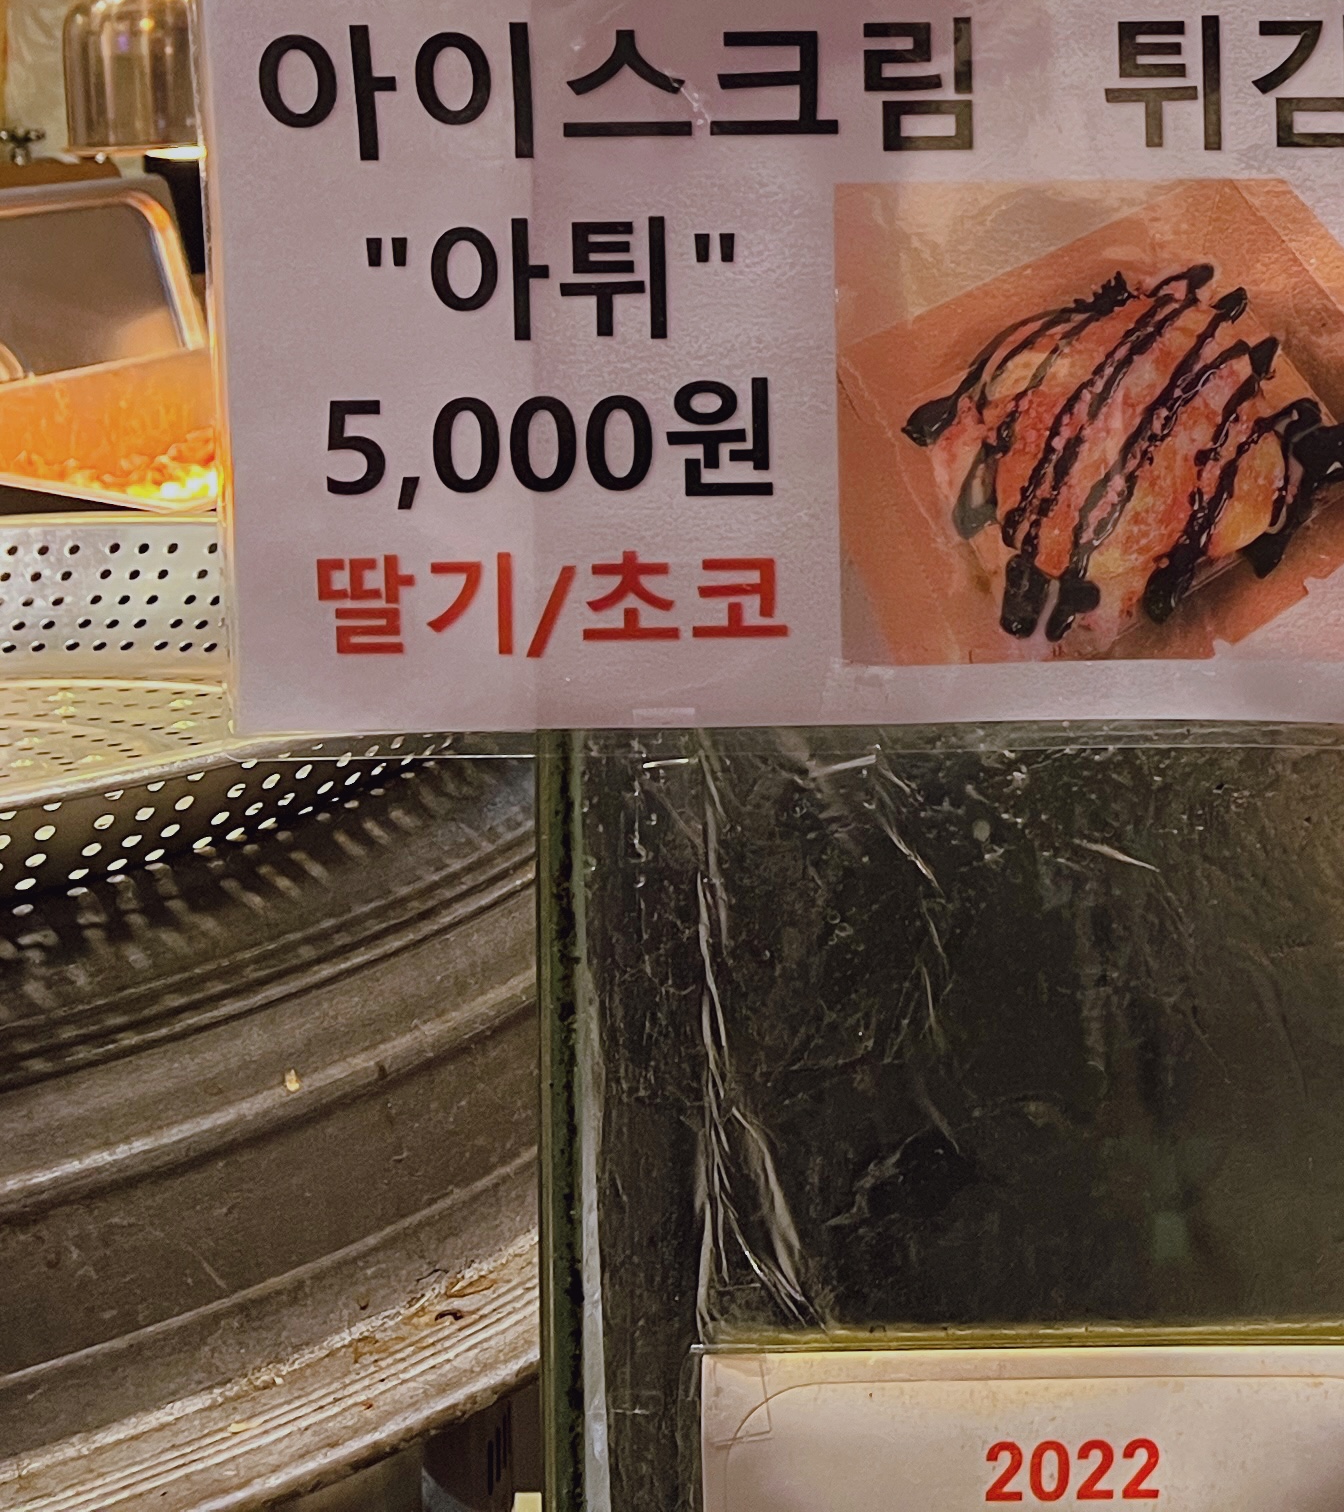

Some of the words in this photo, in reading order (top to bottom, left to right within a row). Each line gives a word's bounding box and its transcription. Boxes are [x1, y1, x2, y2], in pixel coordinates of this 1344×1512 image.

[258, 16, 974, 162] 아이스크림
[365, 215, 736, 342] "아튀"
[326, 376, 774, 510] 5,000원
[316, 550, 790, 659] 딸기/초코
[985, 1437, 1160, 1503] 2022
